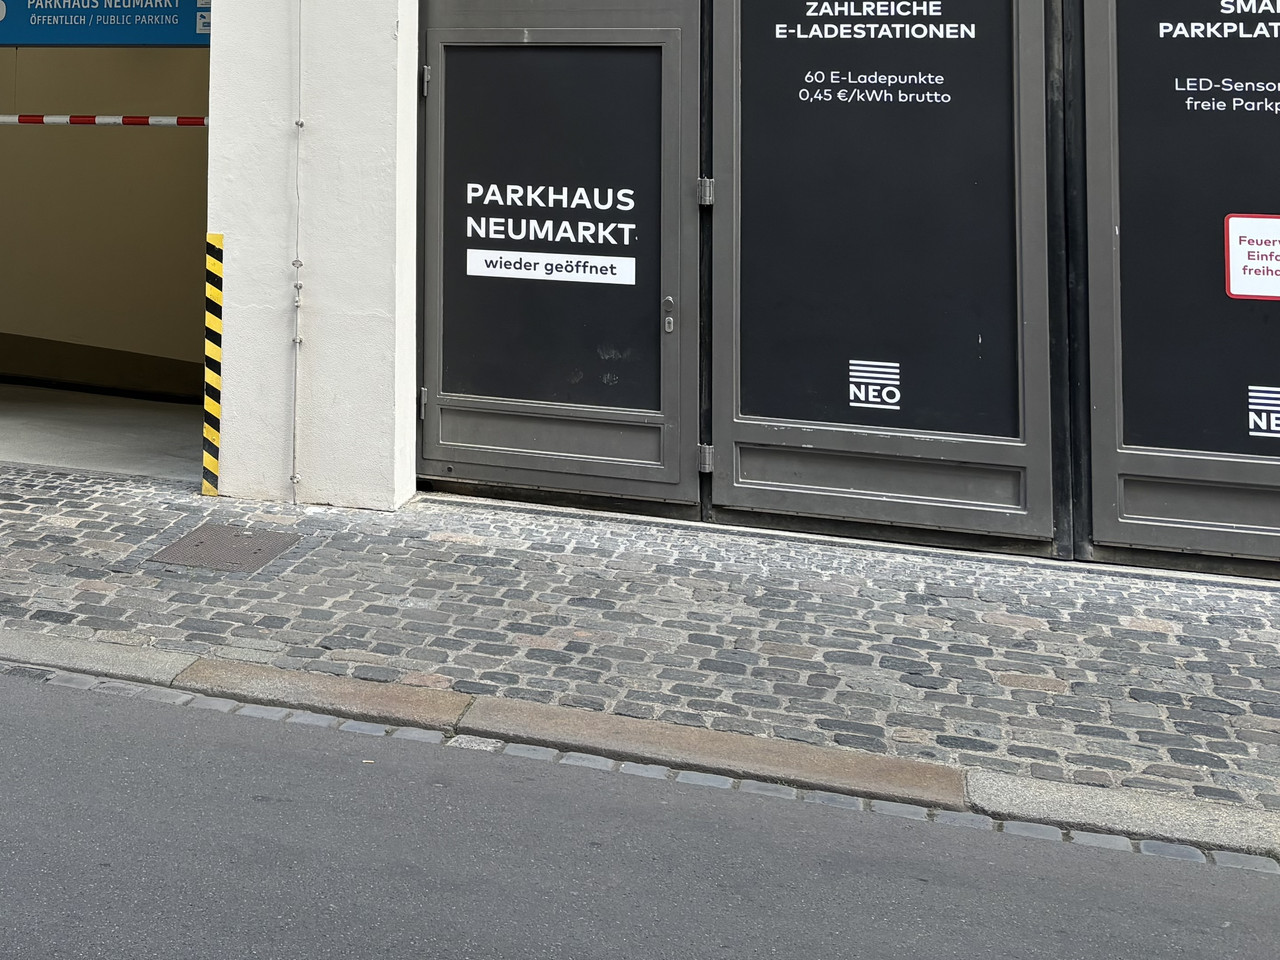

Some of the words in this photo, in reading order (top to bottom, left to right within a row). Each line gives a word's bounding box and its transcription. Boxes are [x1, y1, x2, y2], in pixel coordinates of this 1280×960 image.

[805, 1, 942, 16] ZAHLREICHE
[30, 13, 86, 25] ÖFFENTLICH
[88, 14, 94, 27] /
[96, 14, 132, 25] PUBLIC
[135, 14, 179, 25] PARKING
[775, 23, 976, 39] E-LADESTATIONEN
[1159, 21, 1280, 38] PARKPLAT
[804, 70, 825, 84] 60
[830, 71, 945, 87] E-Ladepunkte
[798, 89, 832, 102] 0,45
[837, 89, 893, 103] €/kWh
[898, 89, 951, 103] brutto
[1185, 97, 1226, 111] freie
[467, 183, 635, 211] PARKHAUS
[467, 216, 636, 245] NEUMARKT
[1238, 235, 1280, 246] Feuer
[484, 256, 540, 271] wieder
[544, 260, 617, 276] geöffnet
[849, 383, 901, 404] NEO
